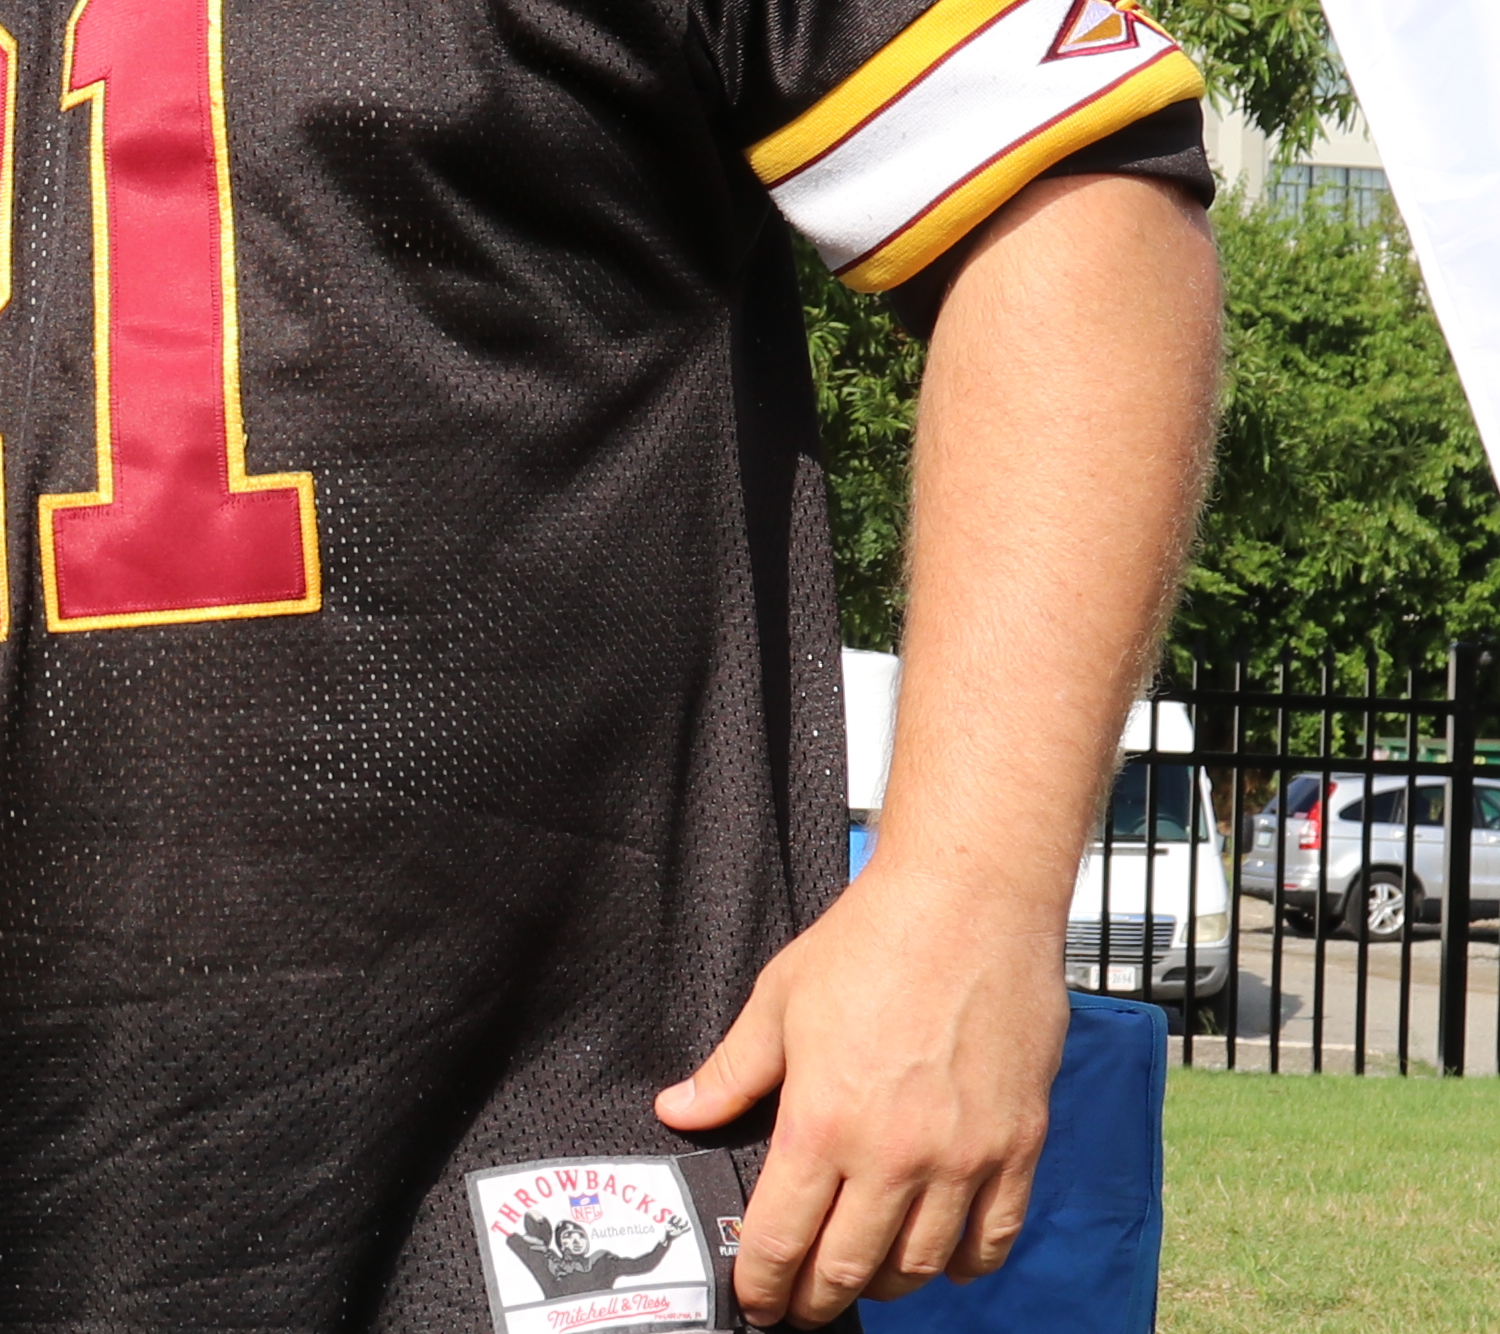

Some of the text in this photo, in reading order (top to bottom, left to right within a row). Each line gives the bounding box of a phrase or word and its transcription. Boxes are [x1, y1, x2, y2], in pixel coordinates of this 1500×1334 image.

[490, 1168, 673, 1238] THROWBACKS
[573, 1205, 602, 1221] NFL
[590, 1223, 655, 1241] Authentics
[547, 1292, 671, 1331] Mitchell & Ness
